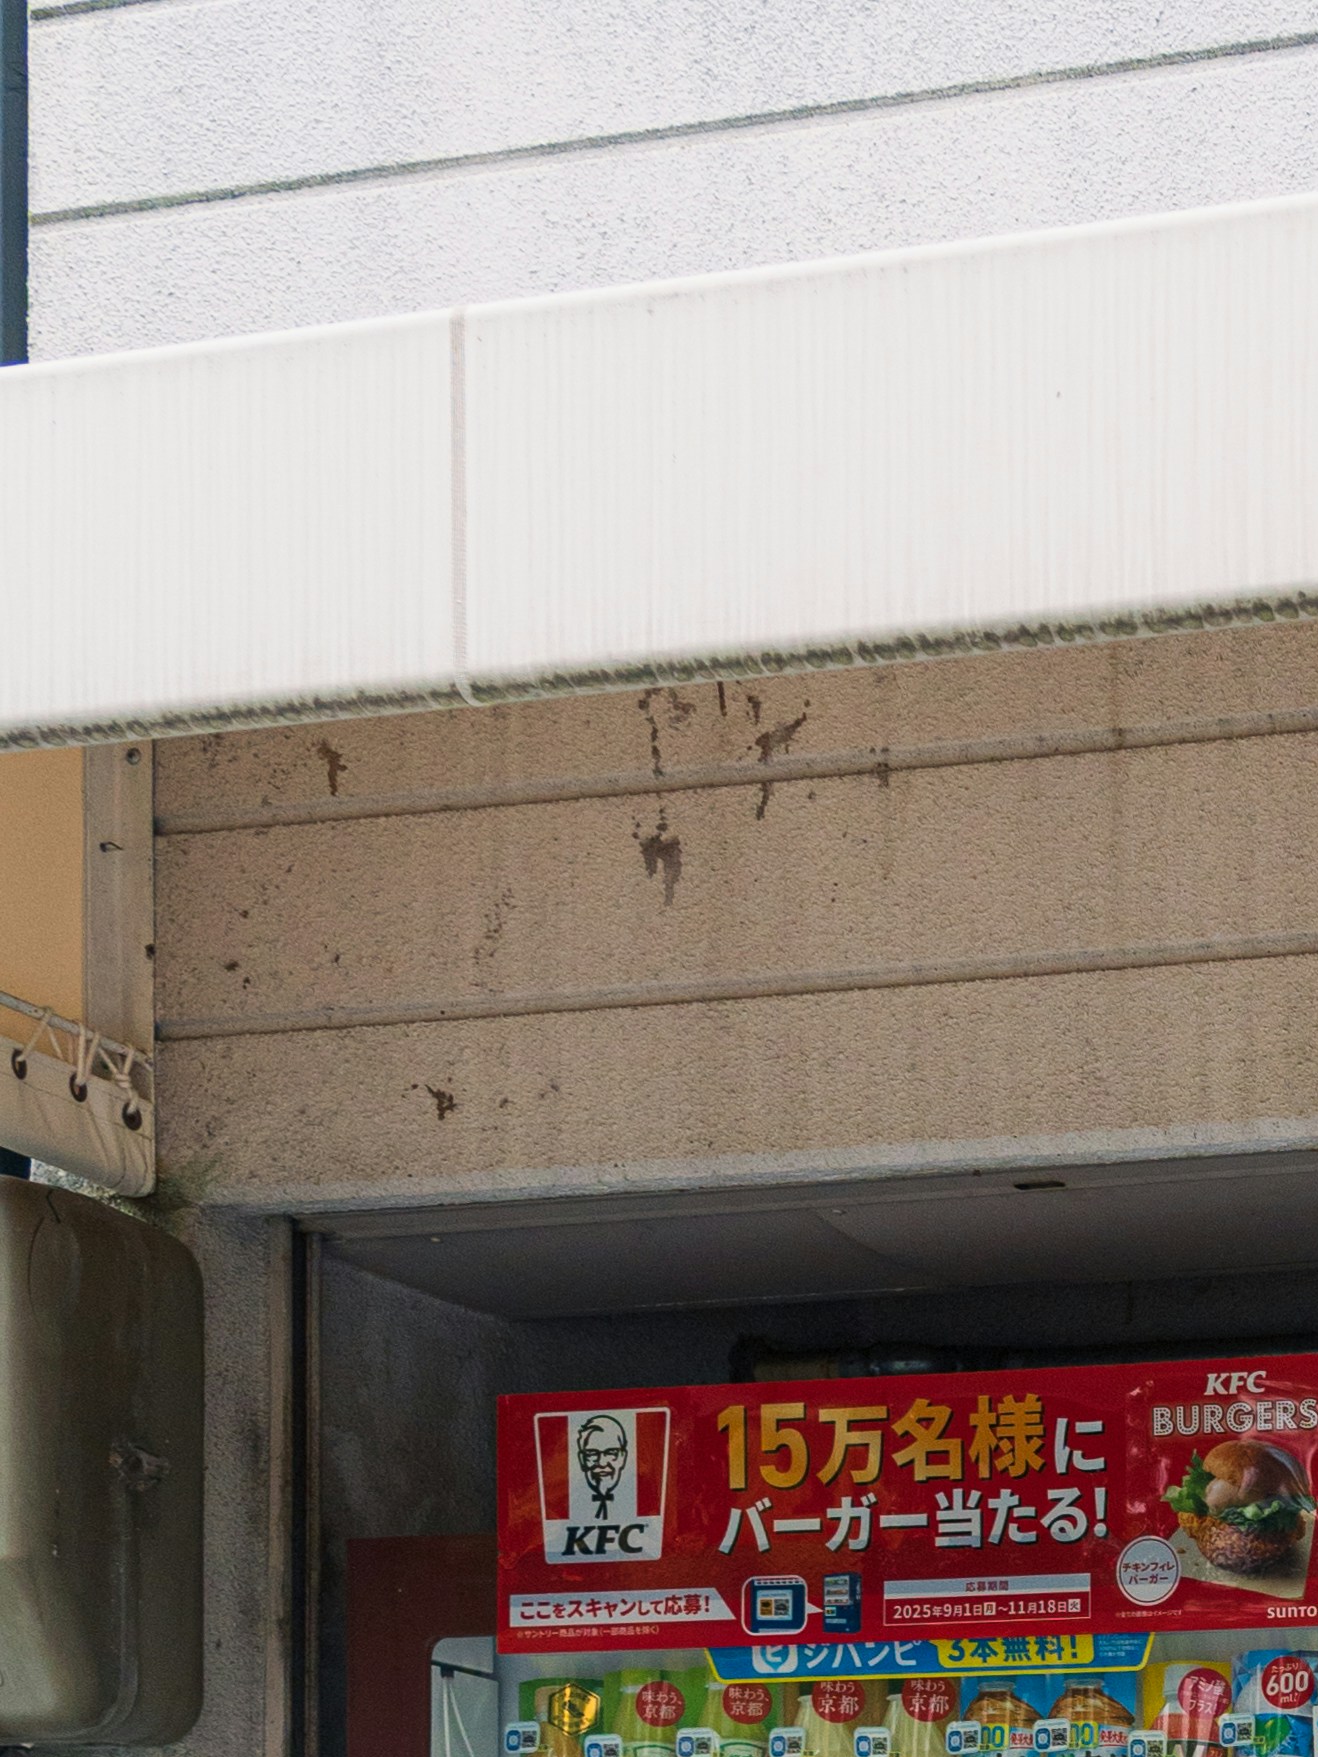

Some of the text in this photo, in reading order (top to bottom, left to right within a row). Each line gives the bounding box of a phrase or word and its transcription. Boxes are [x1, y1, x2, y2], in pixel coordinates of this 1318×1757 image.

[1203, 1370, 1268, 1396] KFC
[716, 1392, 1106, 1491] 15万名様に
[717, 1487, 1108, 1555] バーガー当たる!
[561, 1522, 647, 1556] KFC
[1121, 1560, 1175, 1575] チキンフィレ
[1128, 1572, 1169, 1586] バーガー
[964, 1579, 1010, 1594] 応募期間
[519, 1595, 710, 1621] ここをスキャンして応募!
[1266, 1671, 1310, 1696] 600
[641, 1702, 675, 1720] 京都
